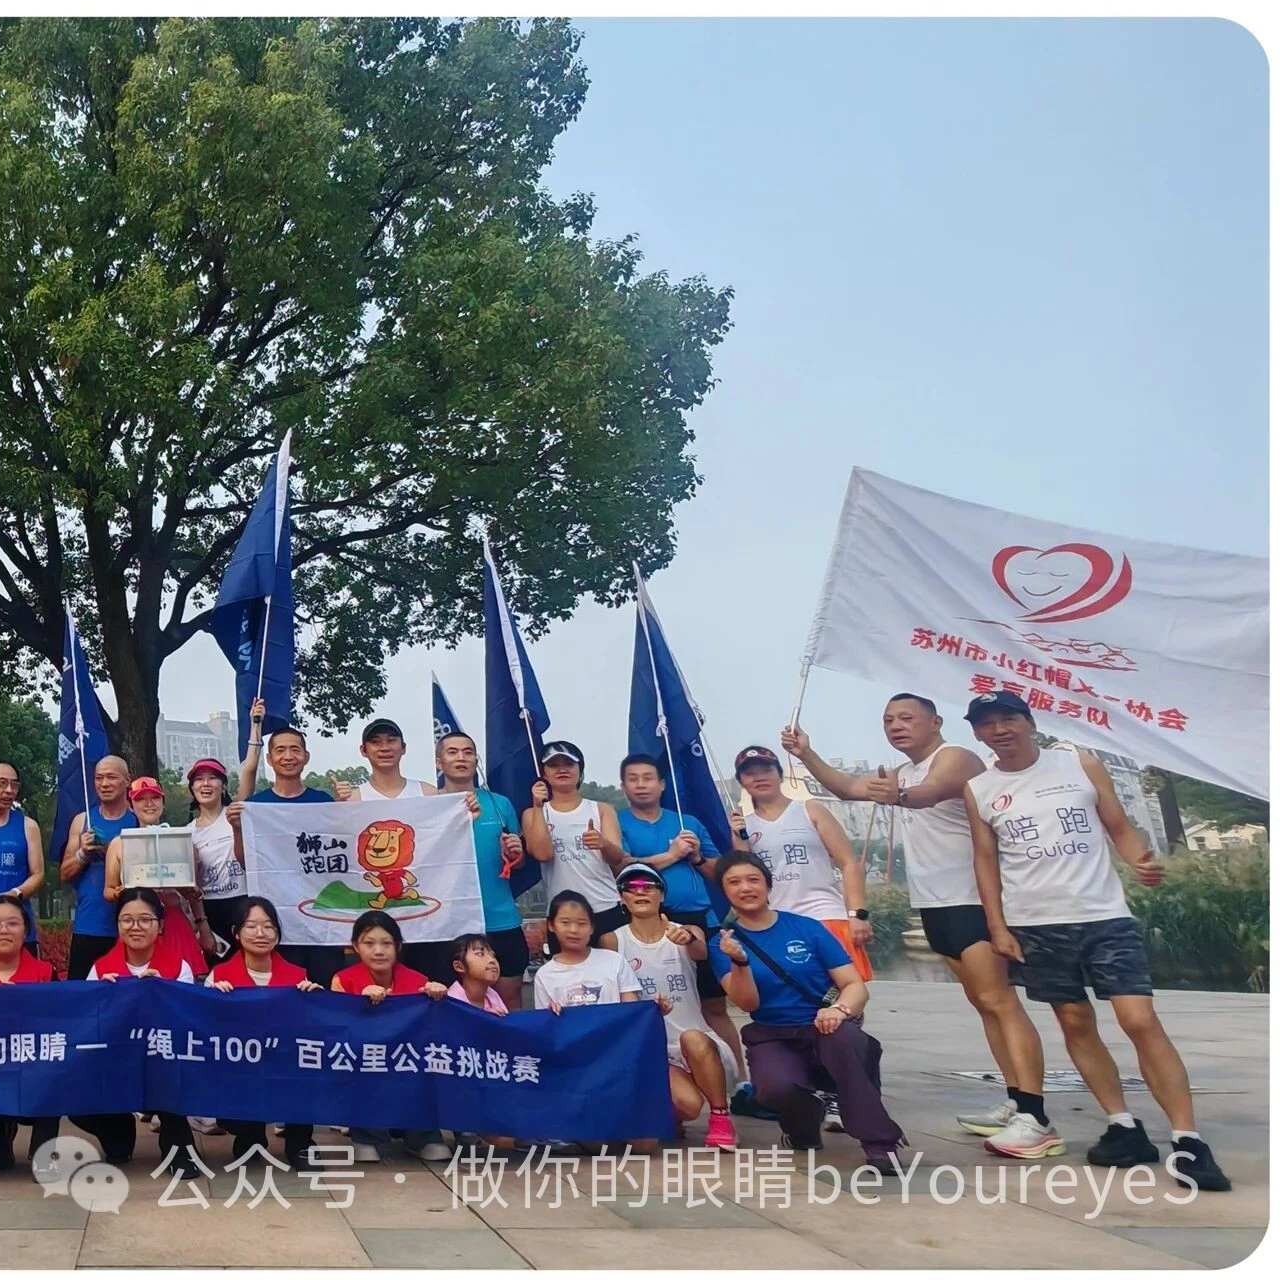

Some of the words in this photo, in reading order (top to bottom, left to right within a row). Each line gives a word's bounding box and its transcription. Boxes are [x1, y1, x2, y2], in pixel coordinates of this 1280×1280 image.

[910, 627, 1190, 732] 苏州市小红帽义协会
[1026, 841, 1089, 860] Guide
[301, 853, 349, 874] 跑团
